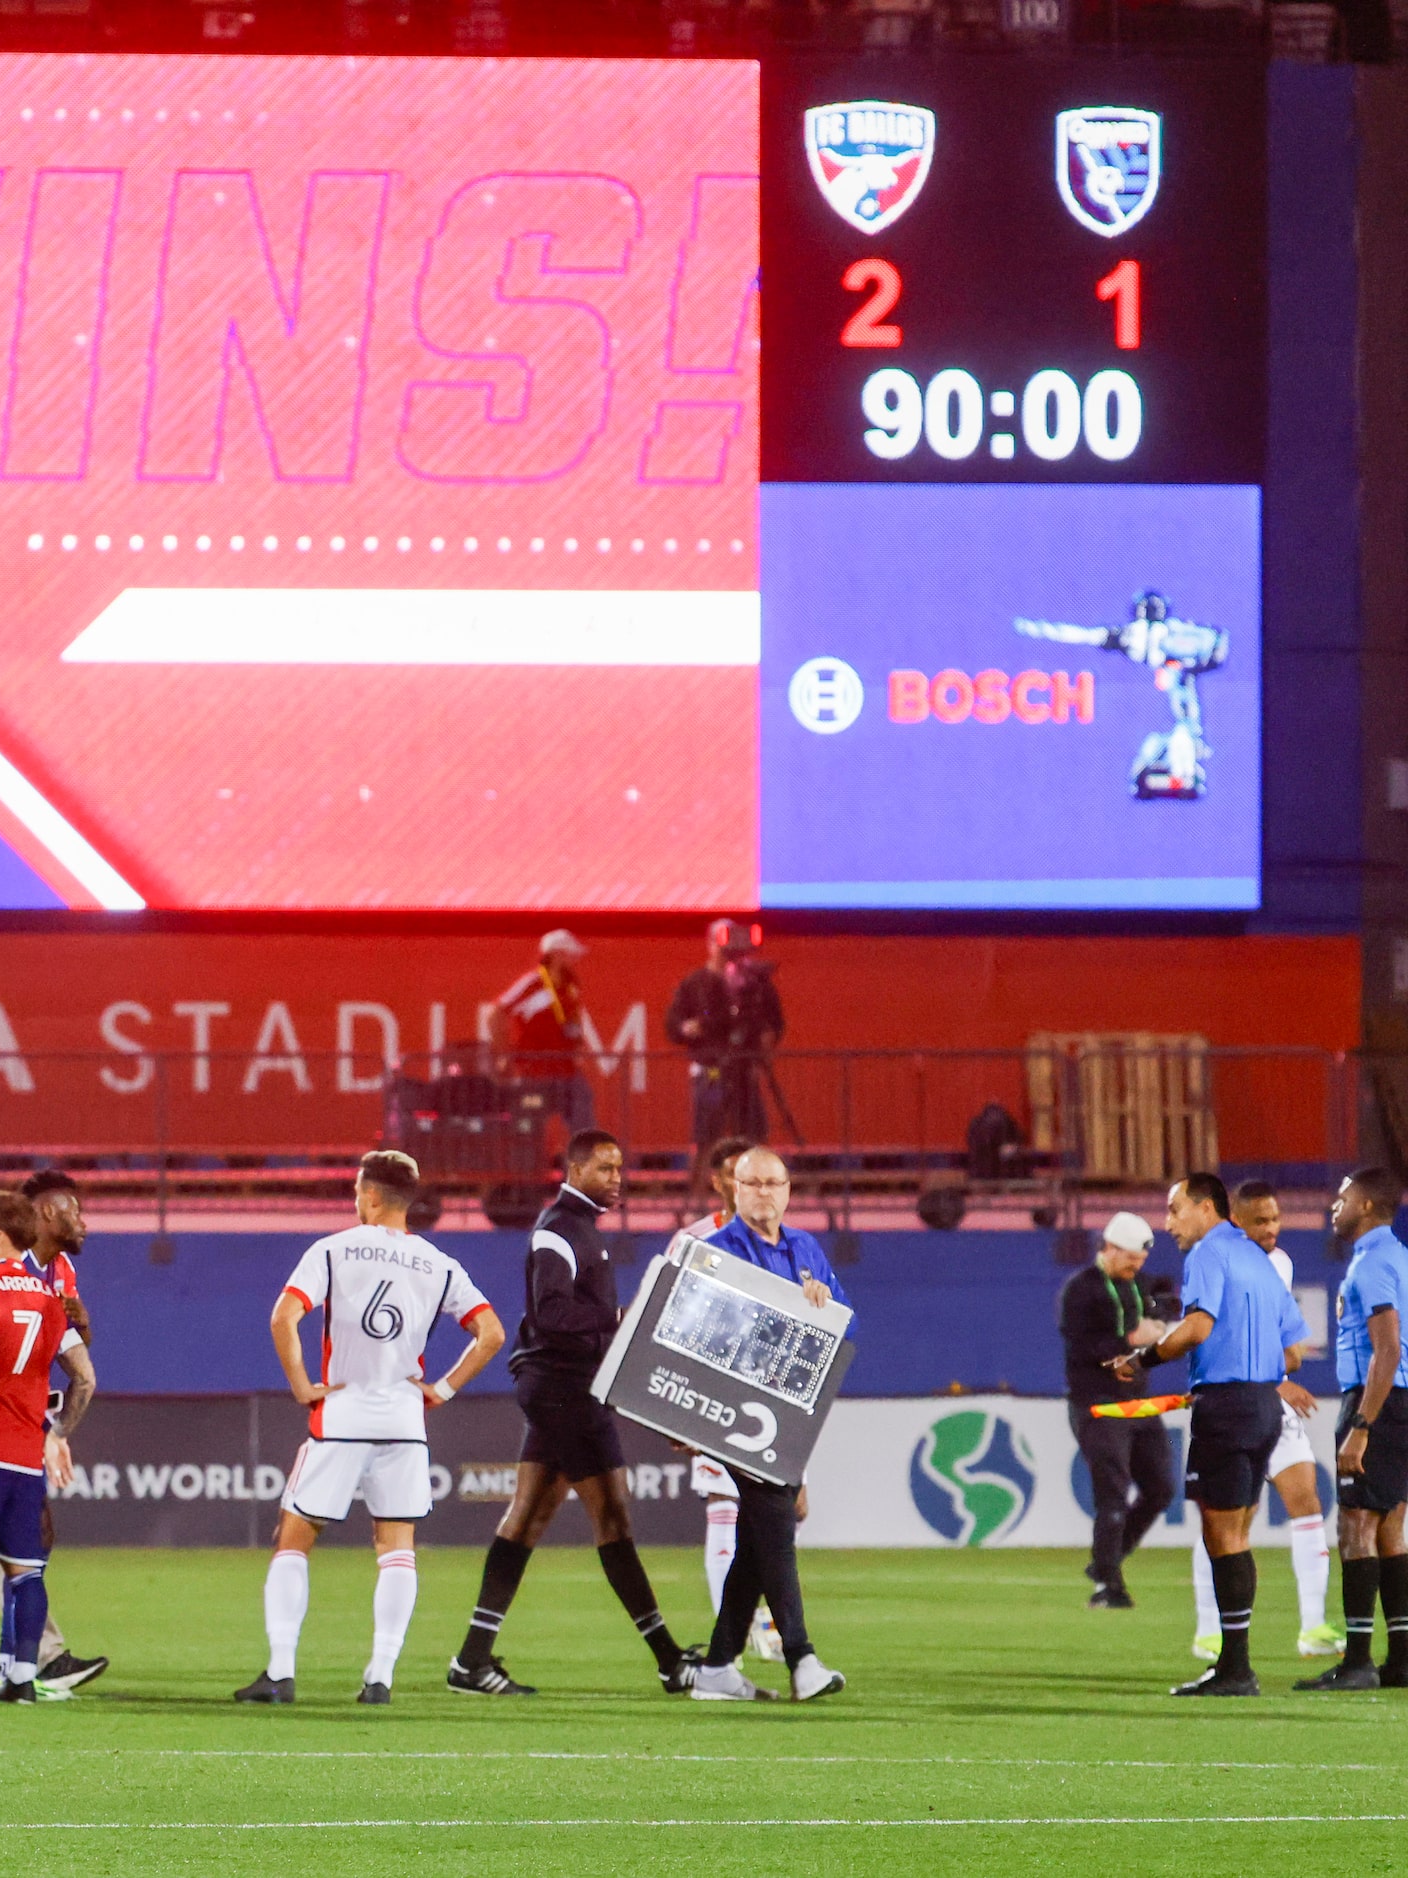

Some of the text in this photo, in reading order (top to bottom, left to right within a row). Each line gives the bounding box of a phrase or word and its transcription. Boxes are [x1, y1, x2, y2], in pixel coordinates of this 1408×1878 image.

[842, 259, 1142, 349] 2 1
[861, 368, 1143, 461] 90:00
[889, 669, 1094, 725] BOSCH
[100, 1000, 647, 1093] STADIM
[344, 1247, 433, 1274] MORALES
[12, 1309, 43, 1375] 7
[361, 1279, 404, 1343] 6
[648, 1373, 737, 1427] CELSIUS
[126, 1463, 286, 1501] WORLD
